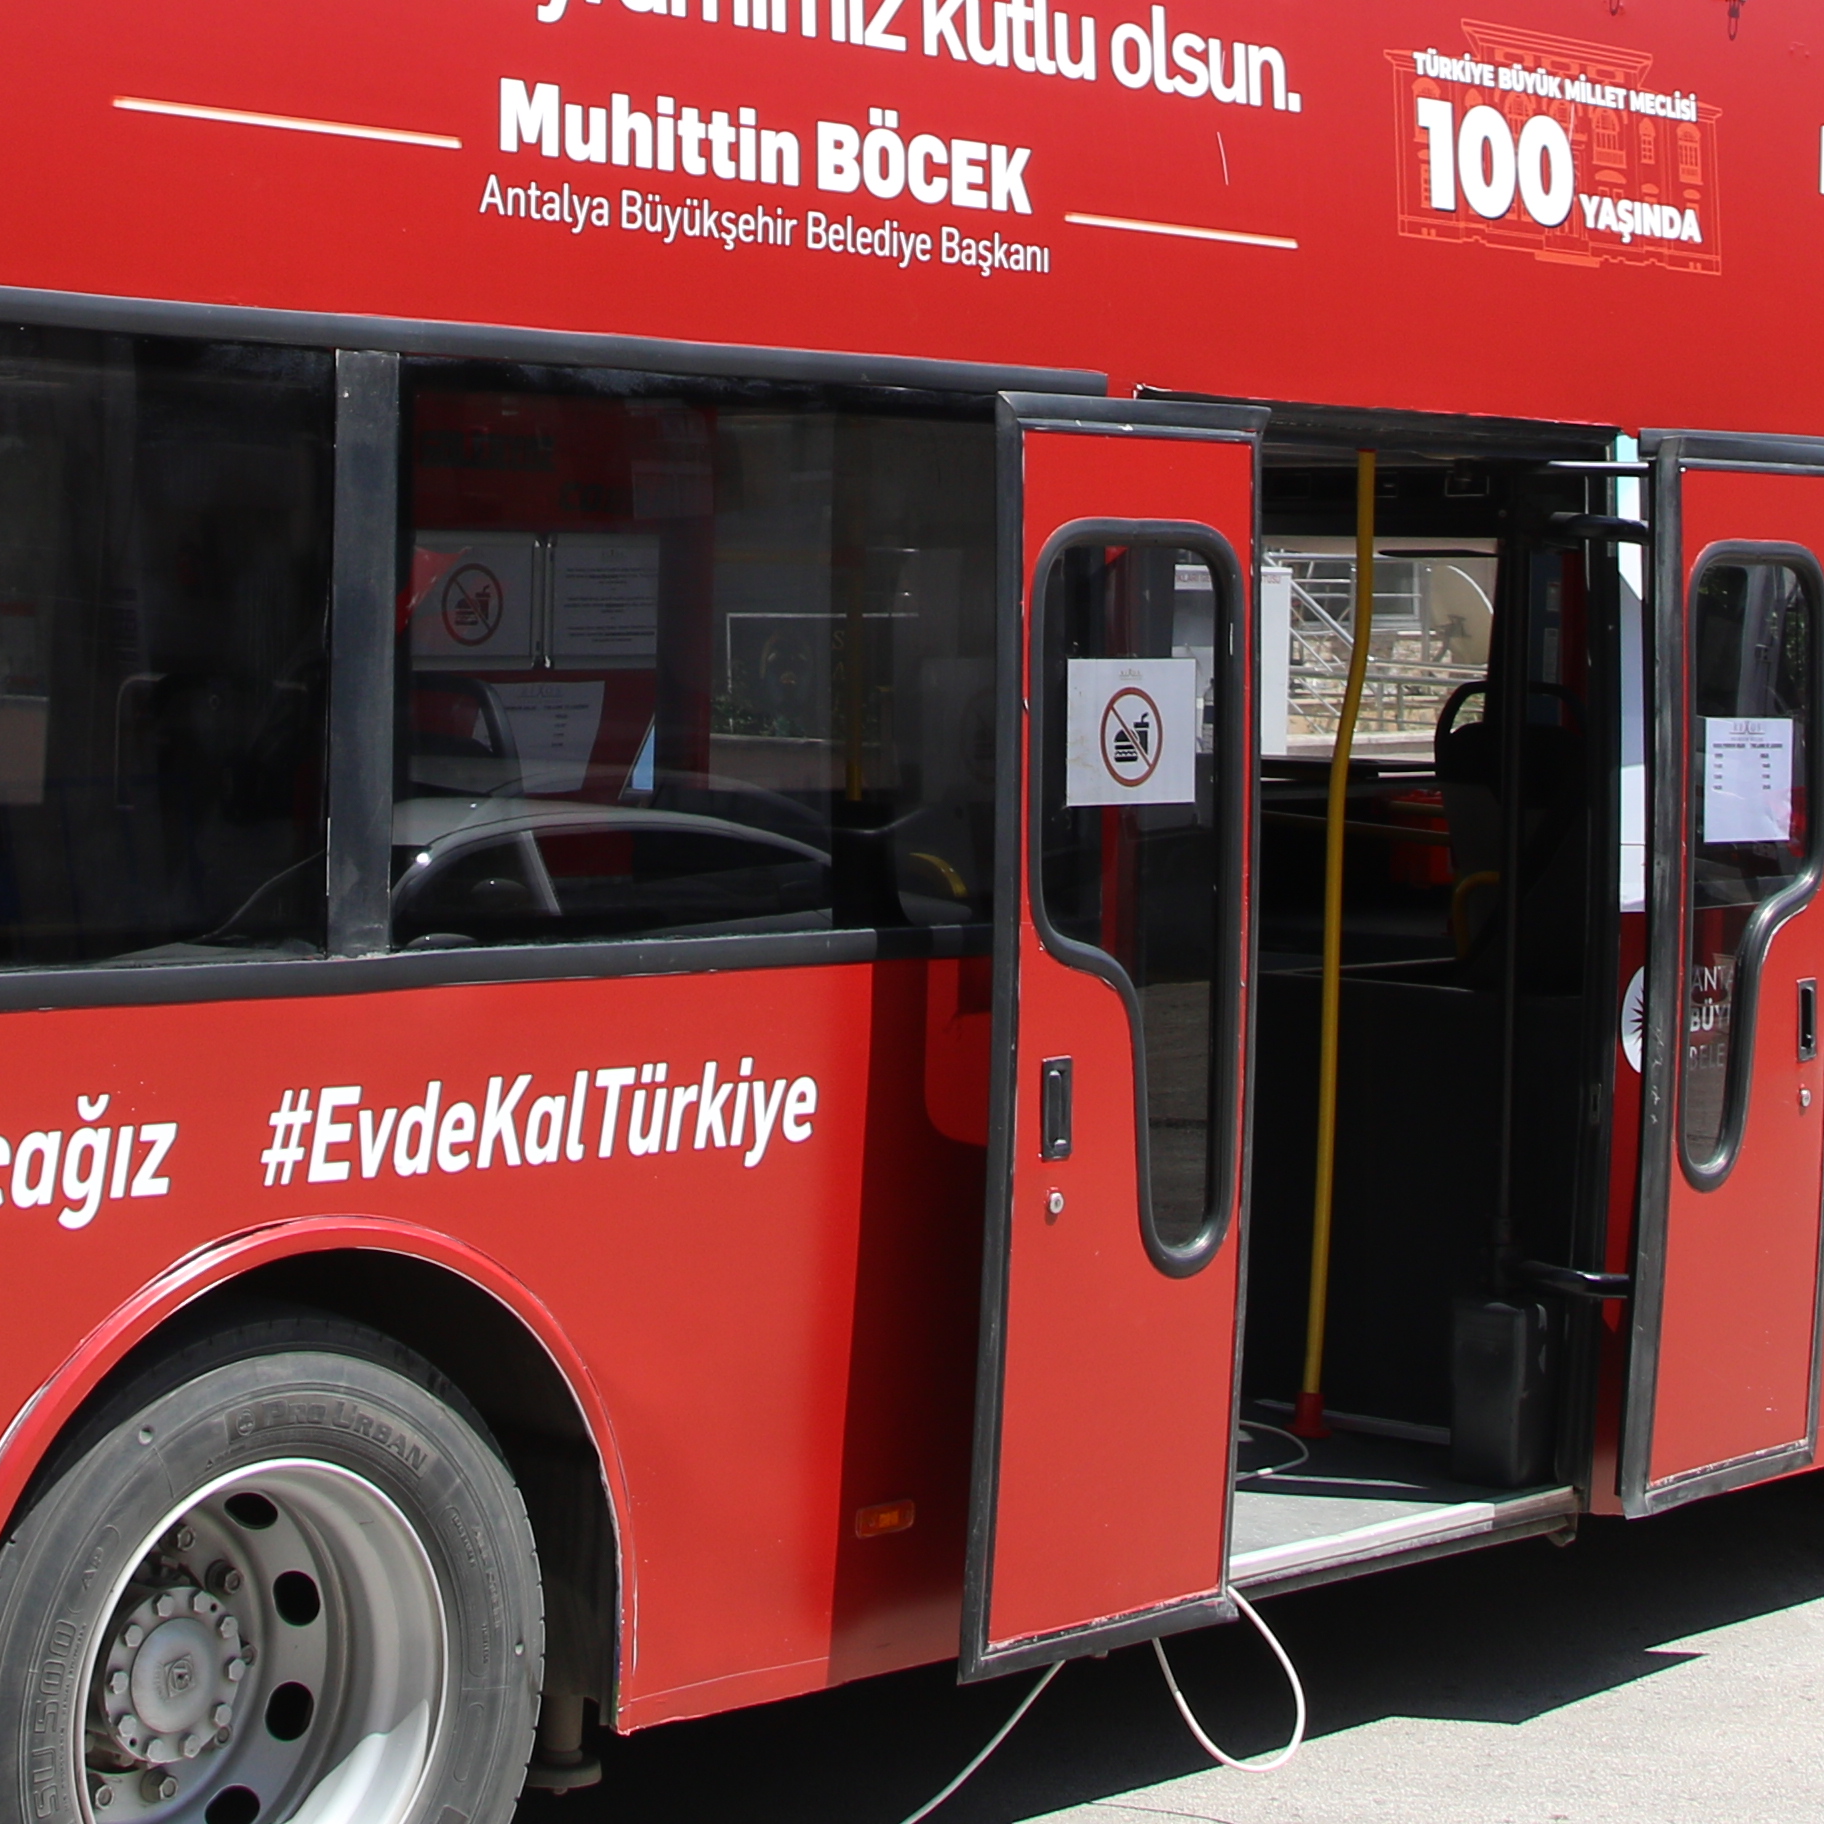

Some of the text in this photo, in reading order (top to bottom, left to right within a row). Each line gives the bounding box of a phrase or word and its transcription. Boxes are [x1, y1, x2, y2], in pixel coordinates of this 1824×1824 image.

[1110, 4, 1302, 113] olsun.
[1412, 47, 1698, 122] TÜRKİYE BÜYÜK MİLLET MECLİSİ
[499, 77, 1033, 215] Muhittin BÖCEK
[1416, 96, 1576, 227] 100
[479, 174, 1050, 277] Antalya Büyükşehir Belediye Başkanı
[1578, 193, 1703, 244] YAŞINDA
[260, 1056, 818, 1187] #EvdeKalTürkiye
